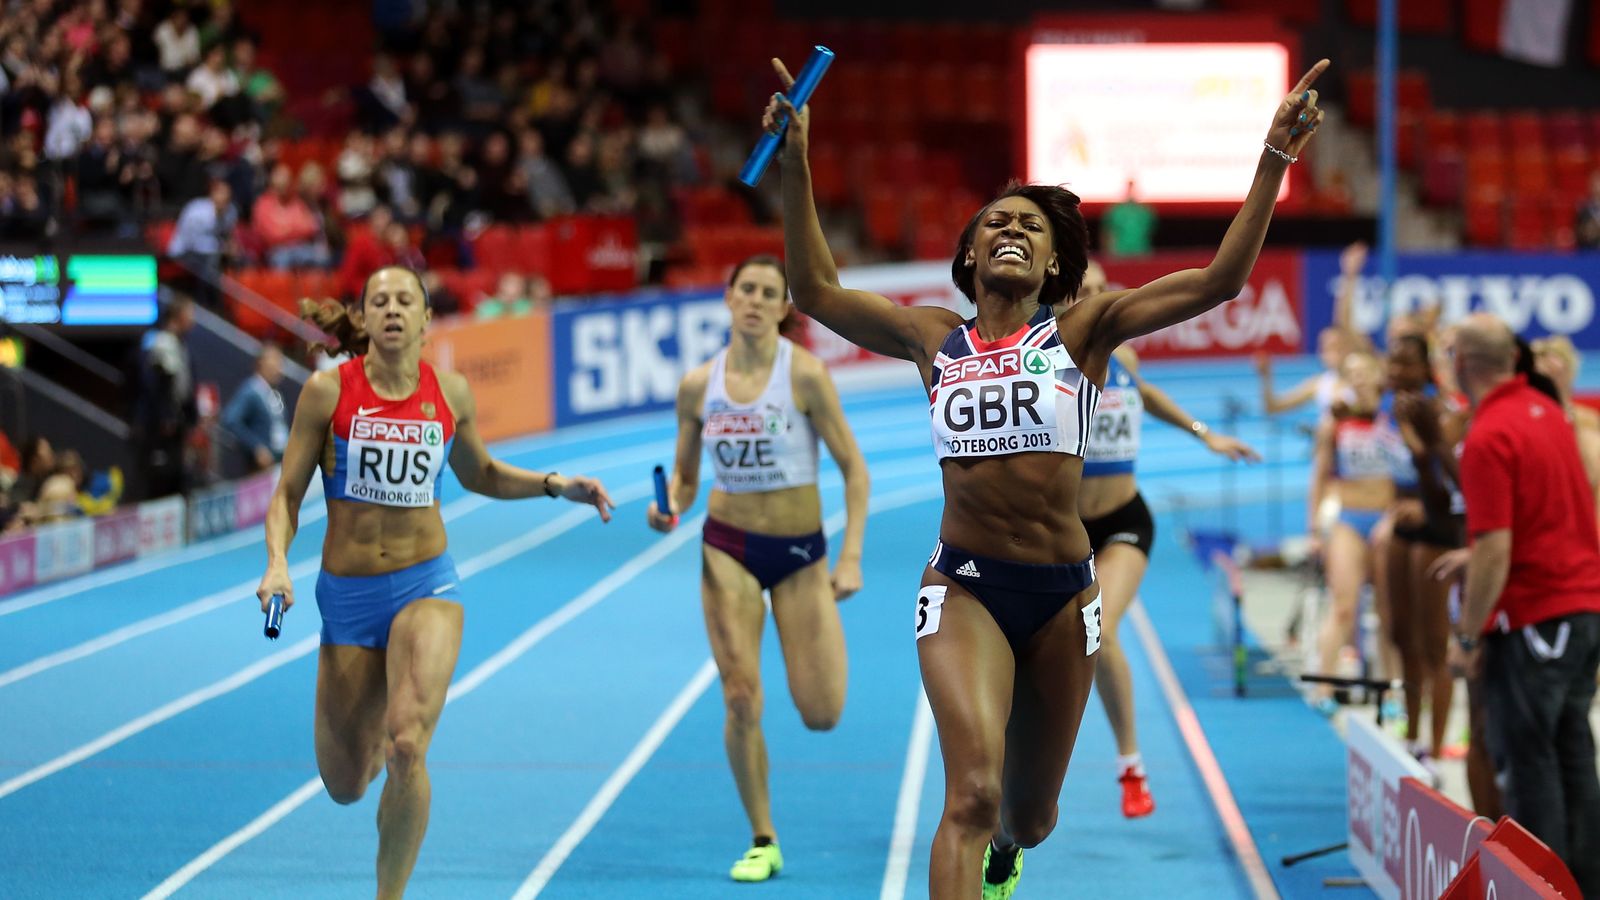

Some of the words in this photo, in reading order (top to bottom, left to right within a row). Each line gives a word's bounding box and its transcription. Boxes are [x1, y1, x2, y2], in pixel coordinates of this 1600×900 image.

[943, 354, 1020, 382] SPAR
[943, 380, 1044, 433] GBR
[354, 420, 421, 443] SPAR
[1022, 432, 1051, 449] 2013
[1095, 412, 1132, 443] RA
[360, 446, 431, 486] RUS
[715, 439, 776, 468] CZE
[351, 482, 412, 504] GÖTEBORG
[956, 568, 981, 578] adidas
